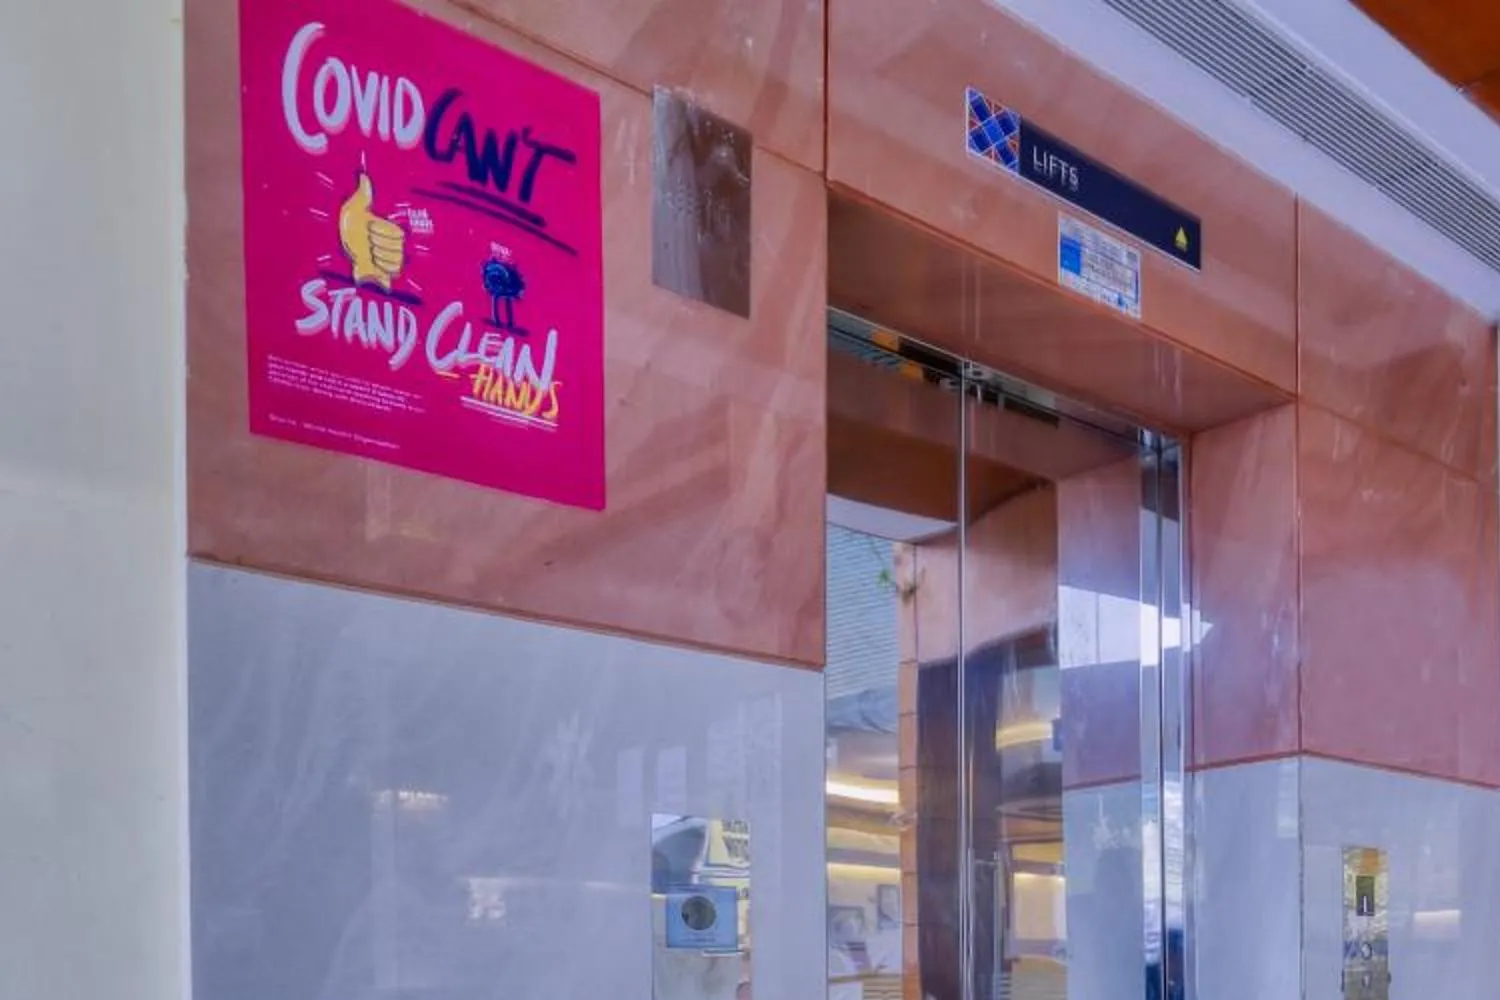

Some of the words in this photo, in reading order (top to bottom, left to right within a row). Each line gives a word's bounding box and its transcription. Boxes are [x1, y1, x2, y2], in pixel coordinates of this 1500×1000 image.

[282, 21, 425, 154] COVID
[423, 88, 577, 205] CAN'T
[1033, 145, 1079, 187] LIFTS
[295, 279, 418, 371] STAND
[425, 301, 558, 392] CLEAN
[469, 362, 562, 421] HANDS
